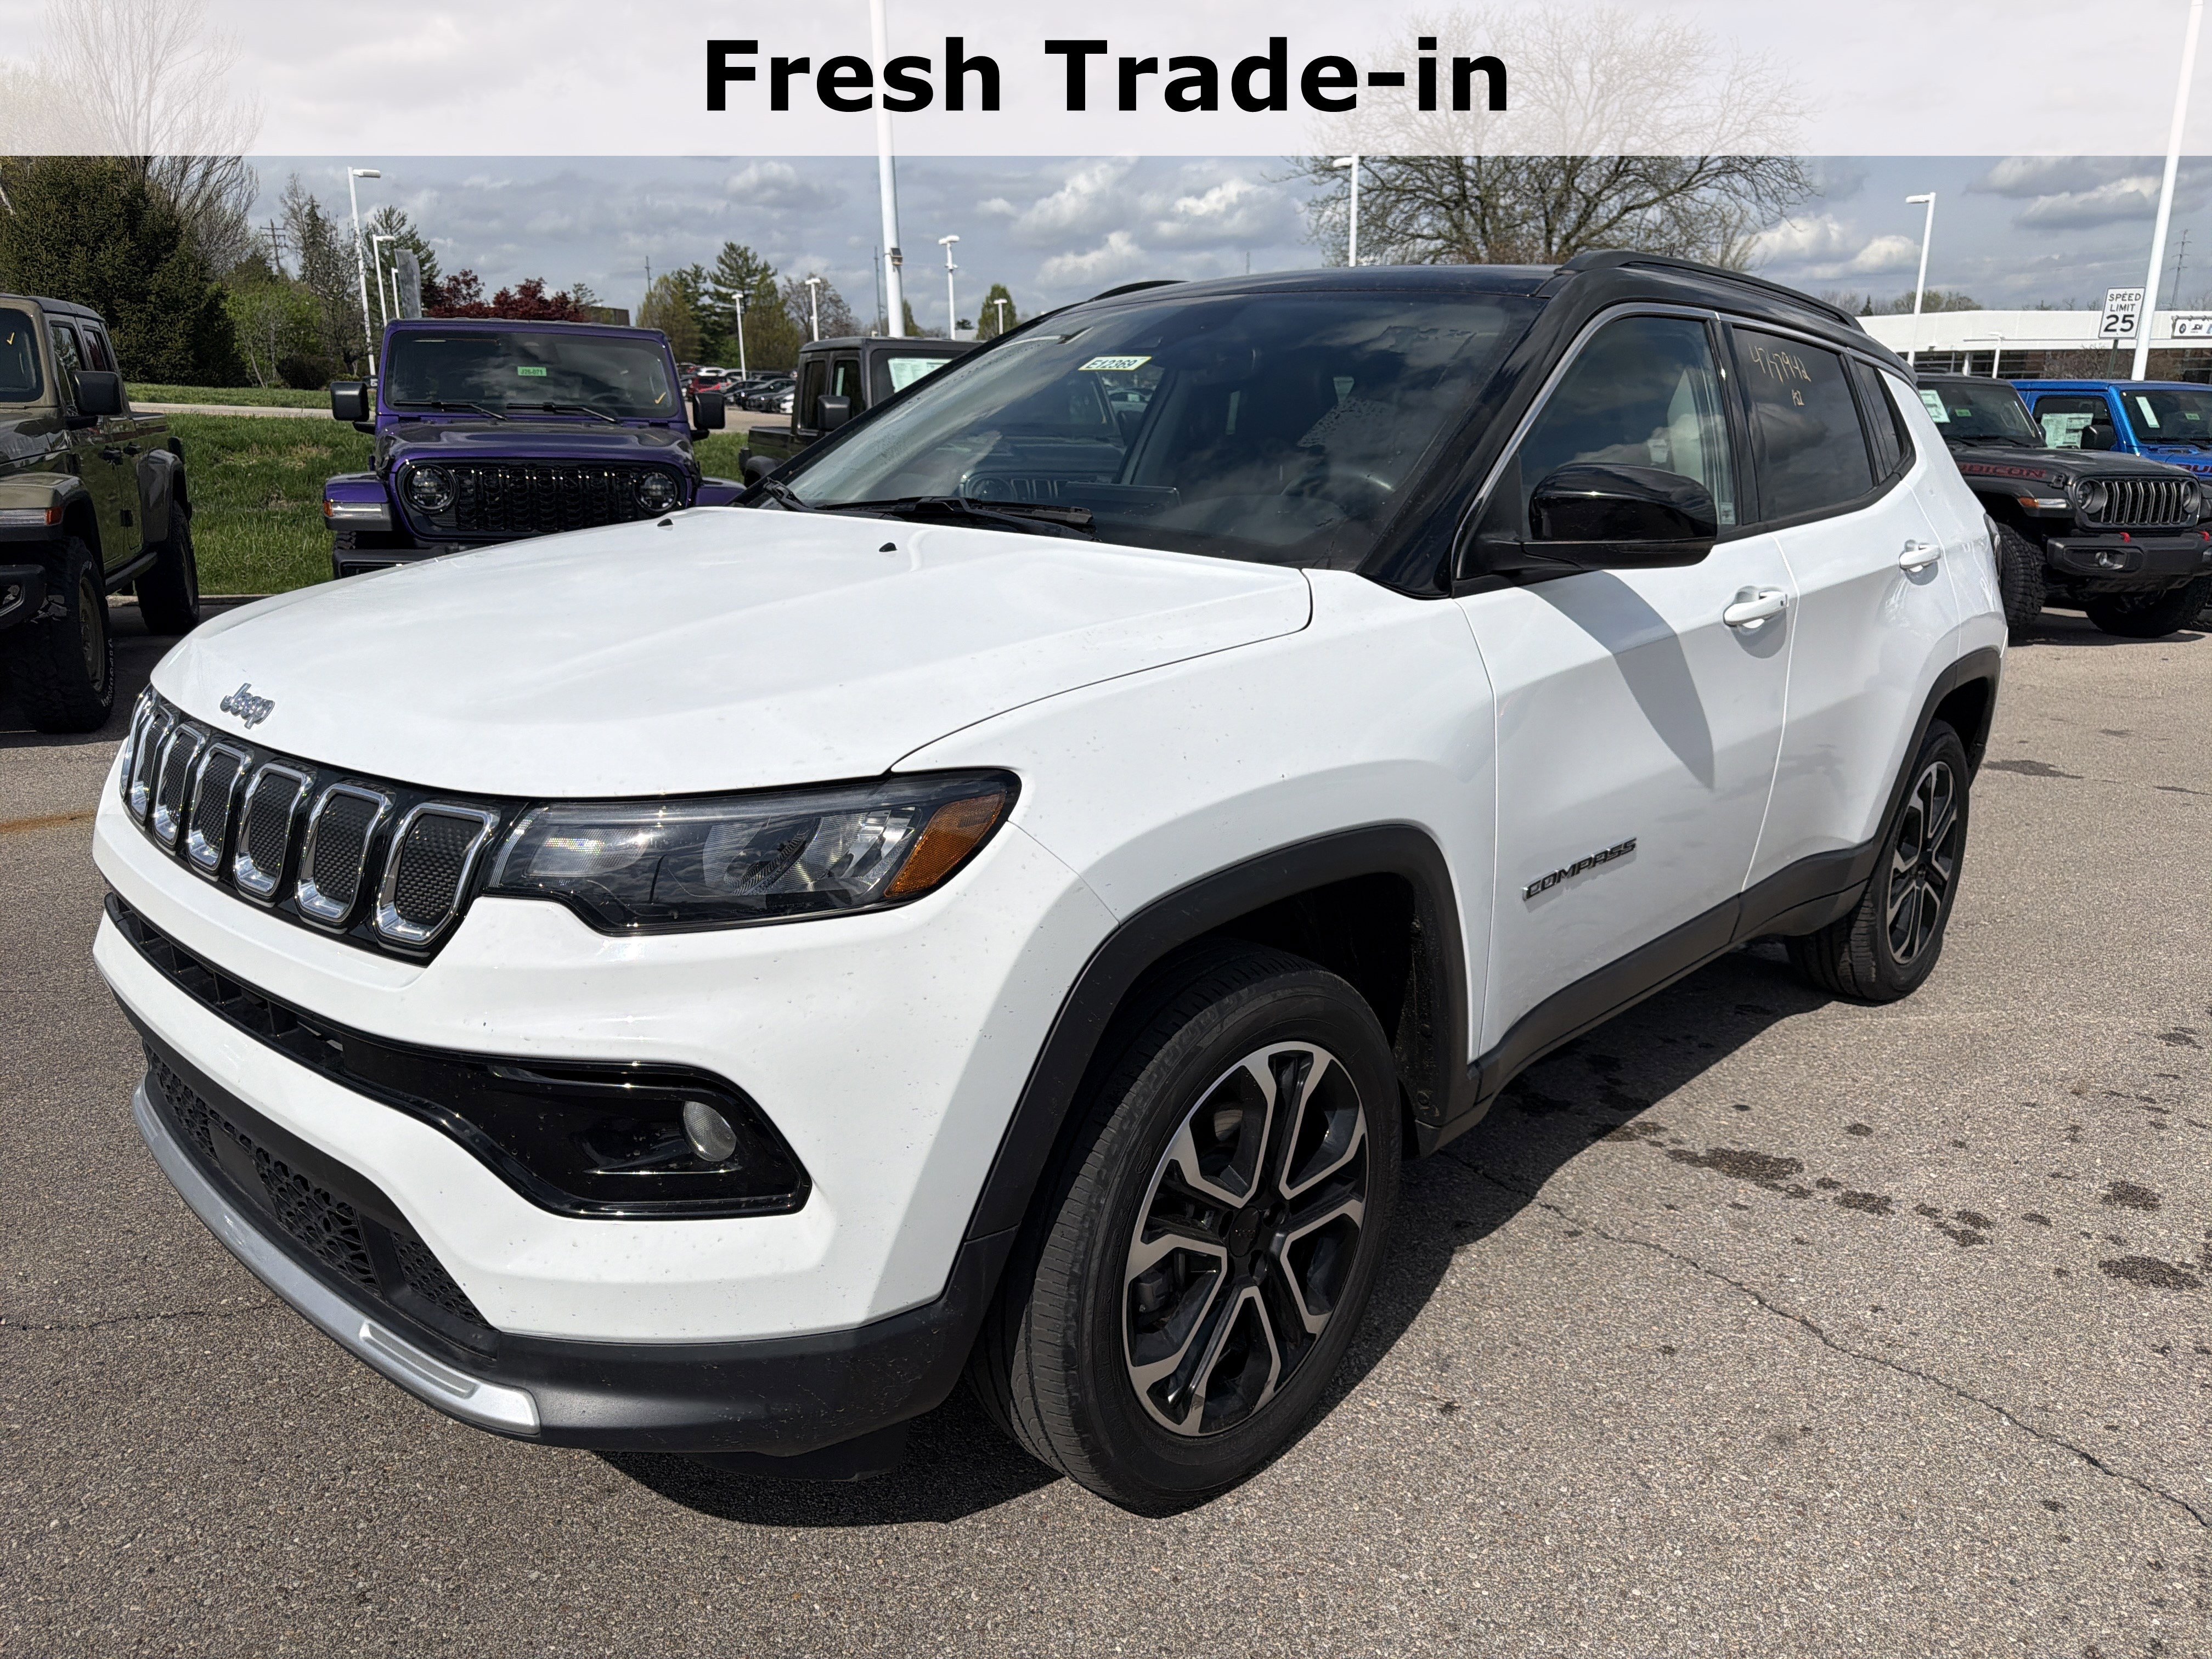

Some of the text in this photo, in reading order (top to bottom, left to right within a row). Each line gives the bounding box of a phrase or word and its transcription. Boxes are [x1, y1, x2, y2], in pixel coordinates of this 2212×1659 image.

[2108, 293, 2141, 302] SPEED
[2110, 303, 2136, 312] LIMIT
[2103, 314, 2135, 332] 25
[1085, 359, 1138, 369] E12369
[1959, 463, 2047, 478] UBICON
[220, 682, 275, 730] Jeep
[1522, 837, 1637, 901] COMPASS
